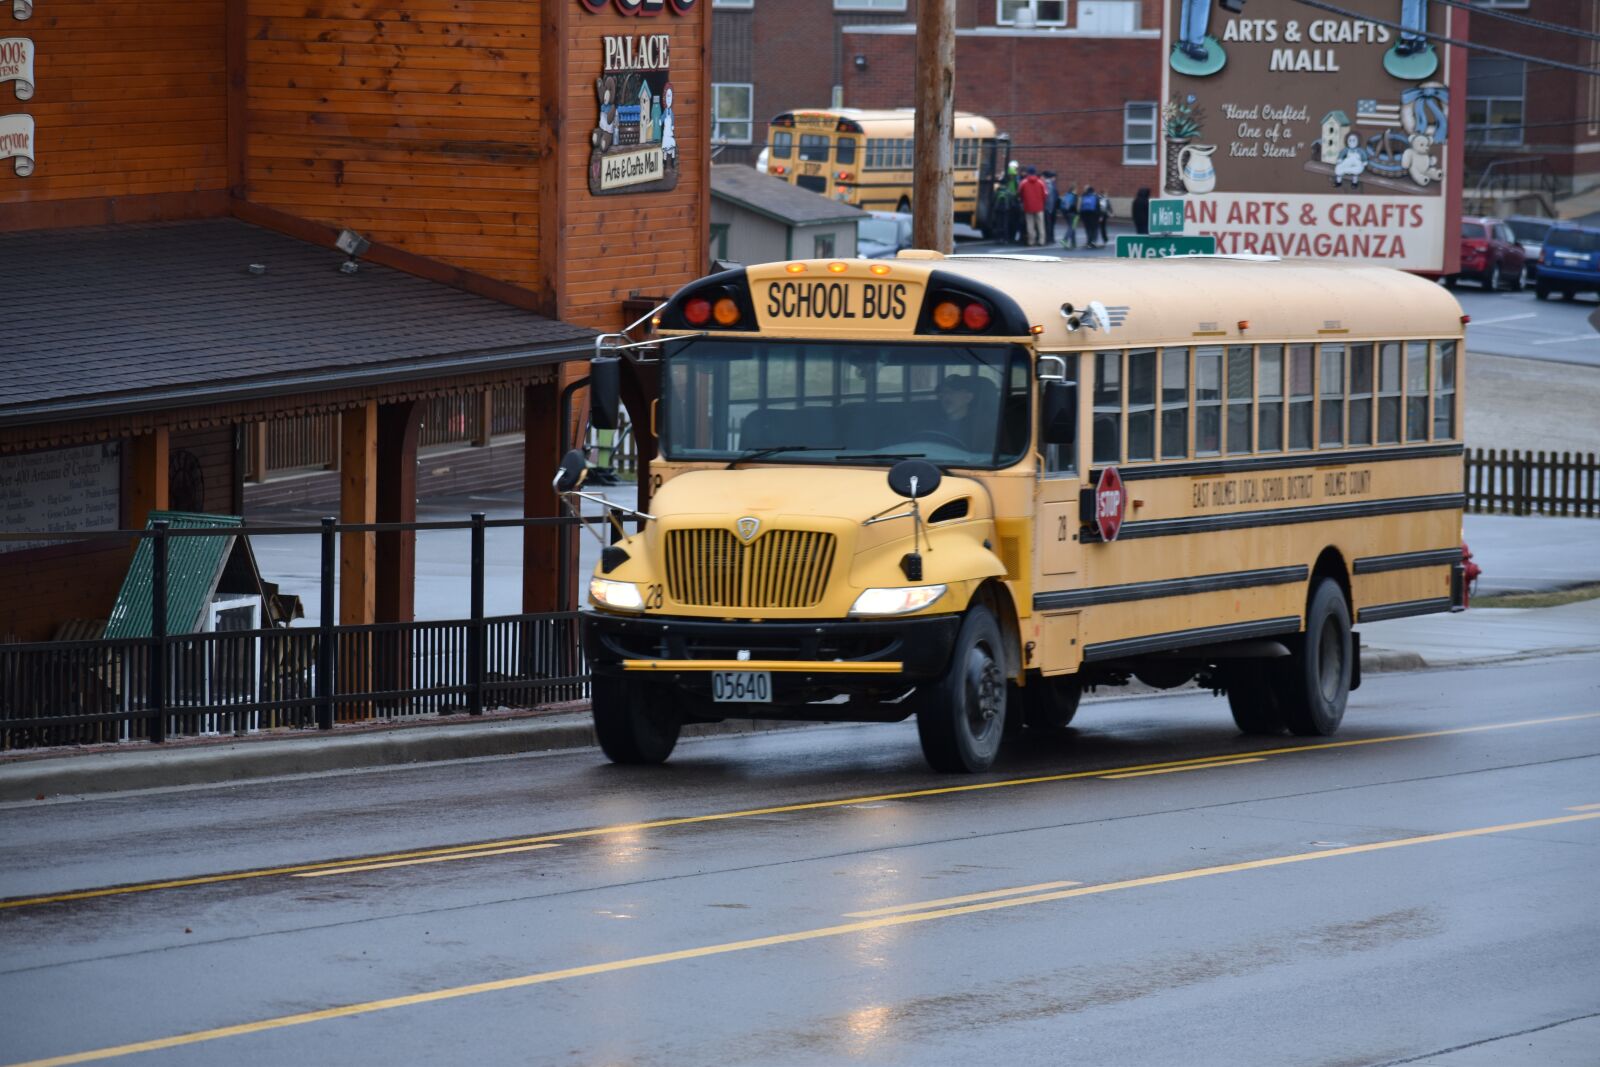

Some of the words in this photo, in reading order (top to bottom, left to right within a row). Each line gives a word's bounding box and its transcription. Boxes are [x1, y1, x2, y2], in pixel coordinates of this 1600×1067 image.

[1223, 20, 1277, 42] ARTS
[1284, 20, 1301, 42] &
[1308, 20, 1390, 43] CRAFTS
[604, 35, 670, 70] PALACE
[1270, 49, 1339, 72] MALL
[1262, 105, 1310, 124] Crafted,
[1238, 122, 1261, 138] One
[1265, 123, 1280, 142] of
[1283, 128, 1292, 138] a
[1229, 142, 1258, 157] Kind
[605, 160, 620, 181] Arts
[621, 158, 627, 178] &
[627, 155, 644, 177] Crafts
[645, 151, 659, 175] Mall
[1159, 206, 1174, 226] Main
[1184, 201, 1217, 224] AN
[1227, 201, 1289, 225] ARTS
[1299, 203, 1317, 226] &
[1328, 203, 1424, 228] CRAFTS
[1127, 243, 1176, 258] West
[1198, 232, 1406, 258] XTRAVAGANZA
[767, 282, 856, 320] SCHOOL
[862, 283, 907, 320] BUS
[1099, 490, 1120, 517] STOP
[645, 583, 663, 609] 28
[714, 672, 768, 700] 05640
